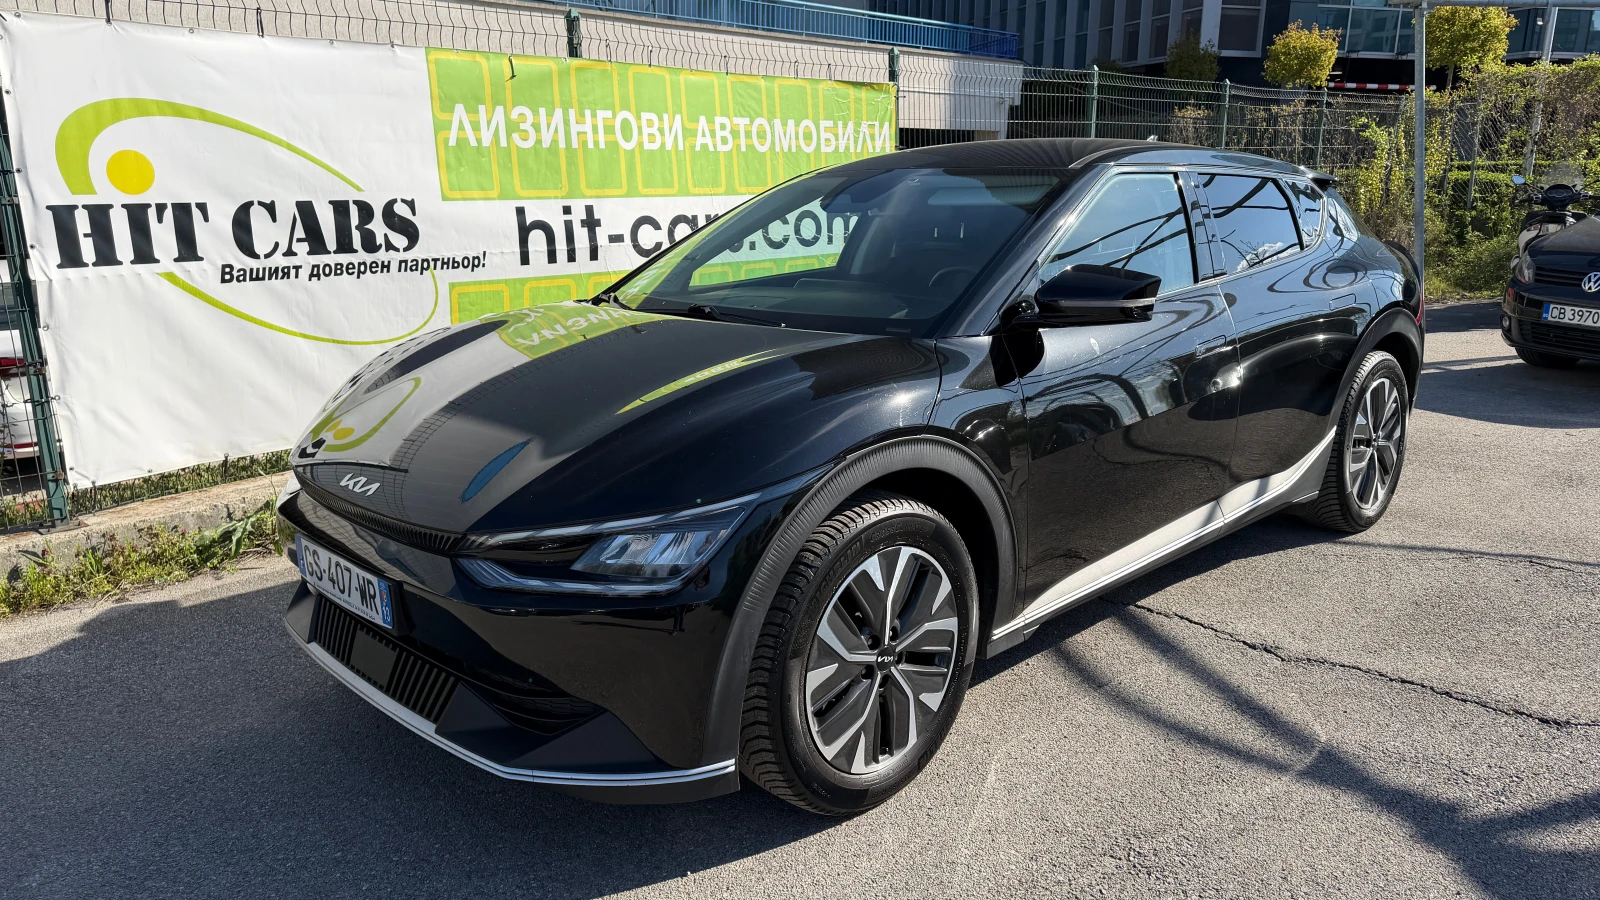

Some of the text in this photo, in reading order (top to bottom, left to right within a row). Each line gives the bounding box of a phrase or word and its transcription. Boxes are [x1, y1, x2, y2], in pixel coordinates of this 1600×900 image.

[448, 104, 891, 153] ЛИЗИНГОВИ АВТОМОБИЛИ
[45, 197, 420, 270] HIT CARS
[514, 204, 860, 267] hit-ca.com
[219, 251, 487, 285] Вашият доверен партньор!
[1550, 306, 1600, 325] CB 3970
[303, 544, 380, 616] GS-407-WR
